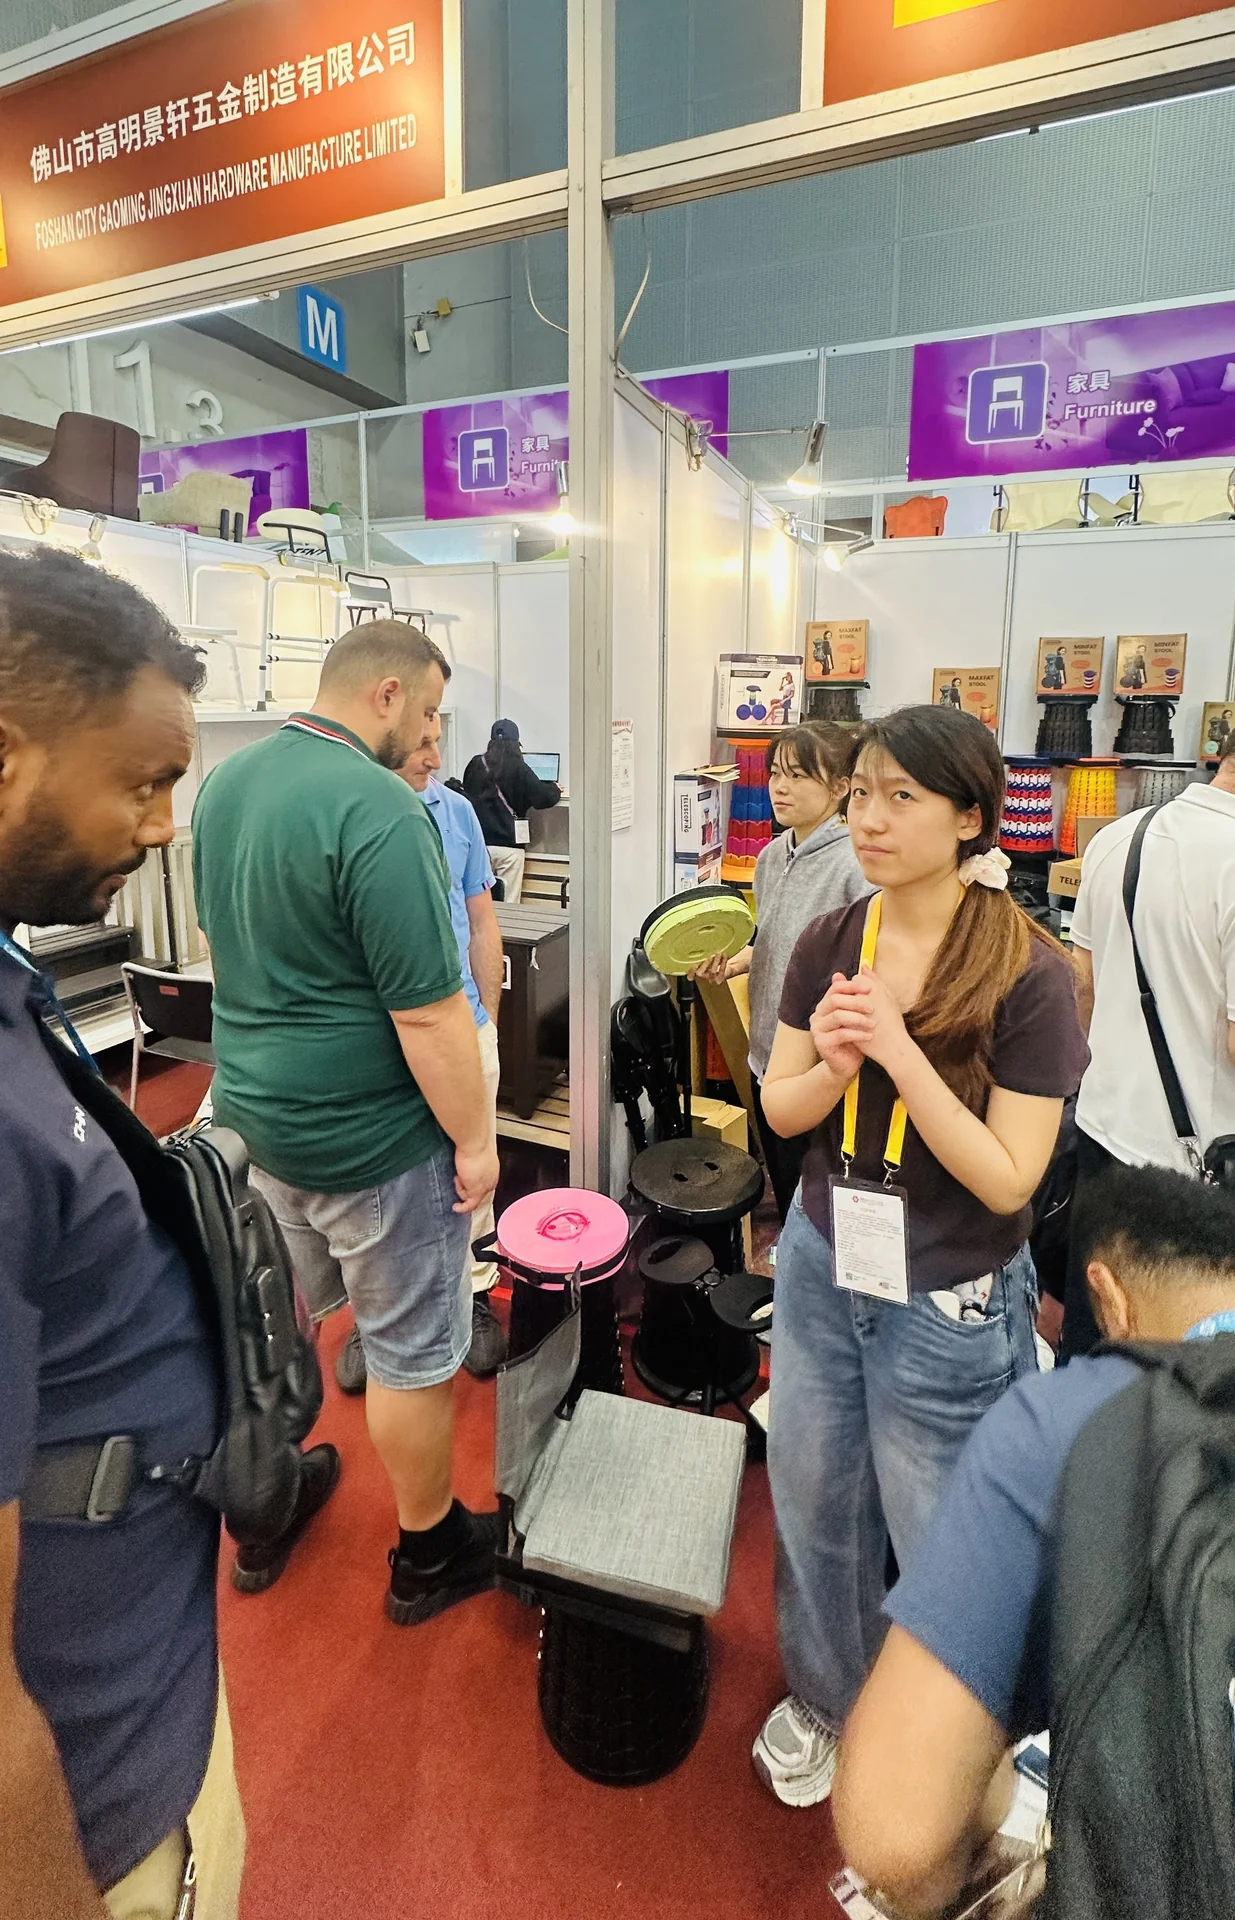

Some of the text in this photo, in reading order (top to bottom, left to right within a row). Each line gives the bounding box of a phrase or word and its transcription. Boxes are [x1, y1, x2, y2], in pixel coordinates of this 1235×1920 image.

[30, 21, 415, 184] 佛山市高明景轩五金制造有限公司
[35, 113, 417, 250] FOSHAN CITY GAOMING JINGXUAN HARDWARE MANUFACTURE LIMITED
[306, 294, 339, 362] M
[1067, 371, 1110, 394] 家具
[1064, 399, 1157, 420] Furniture
[521, 436, 550, 453] 家具
[1060, 875, 1081, 886] TELE
